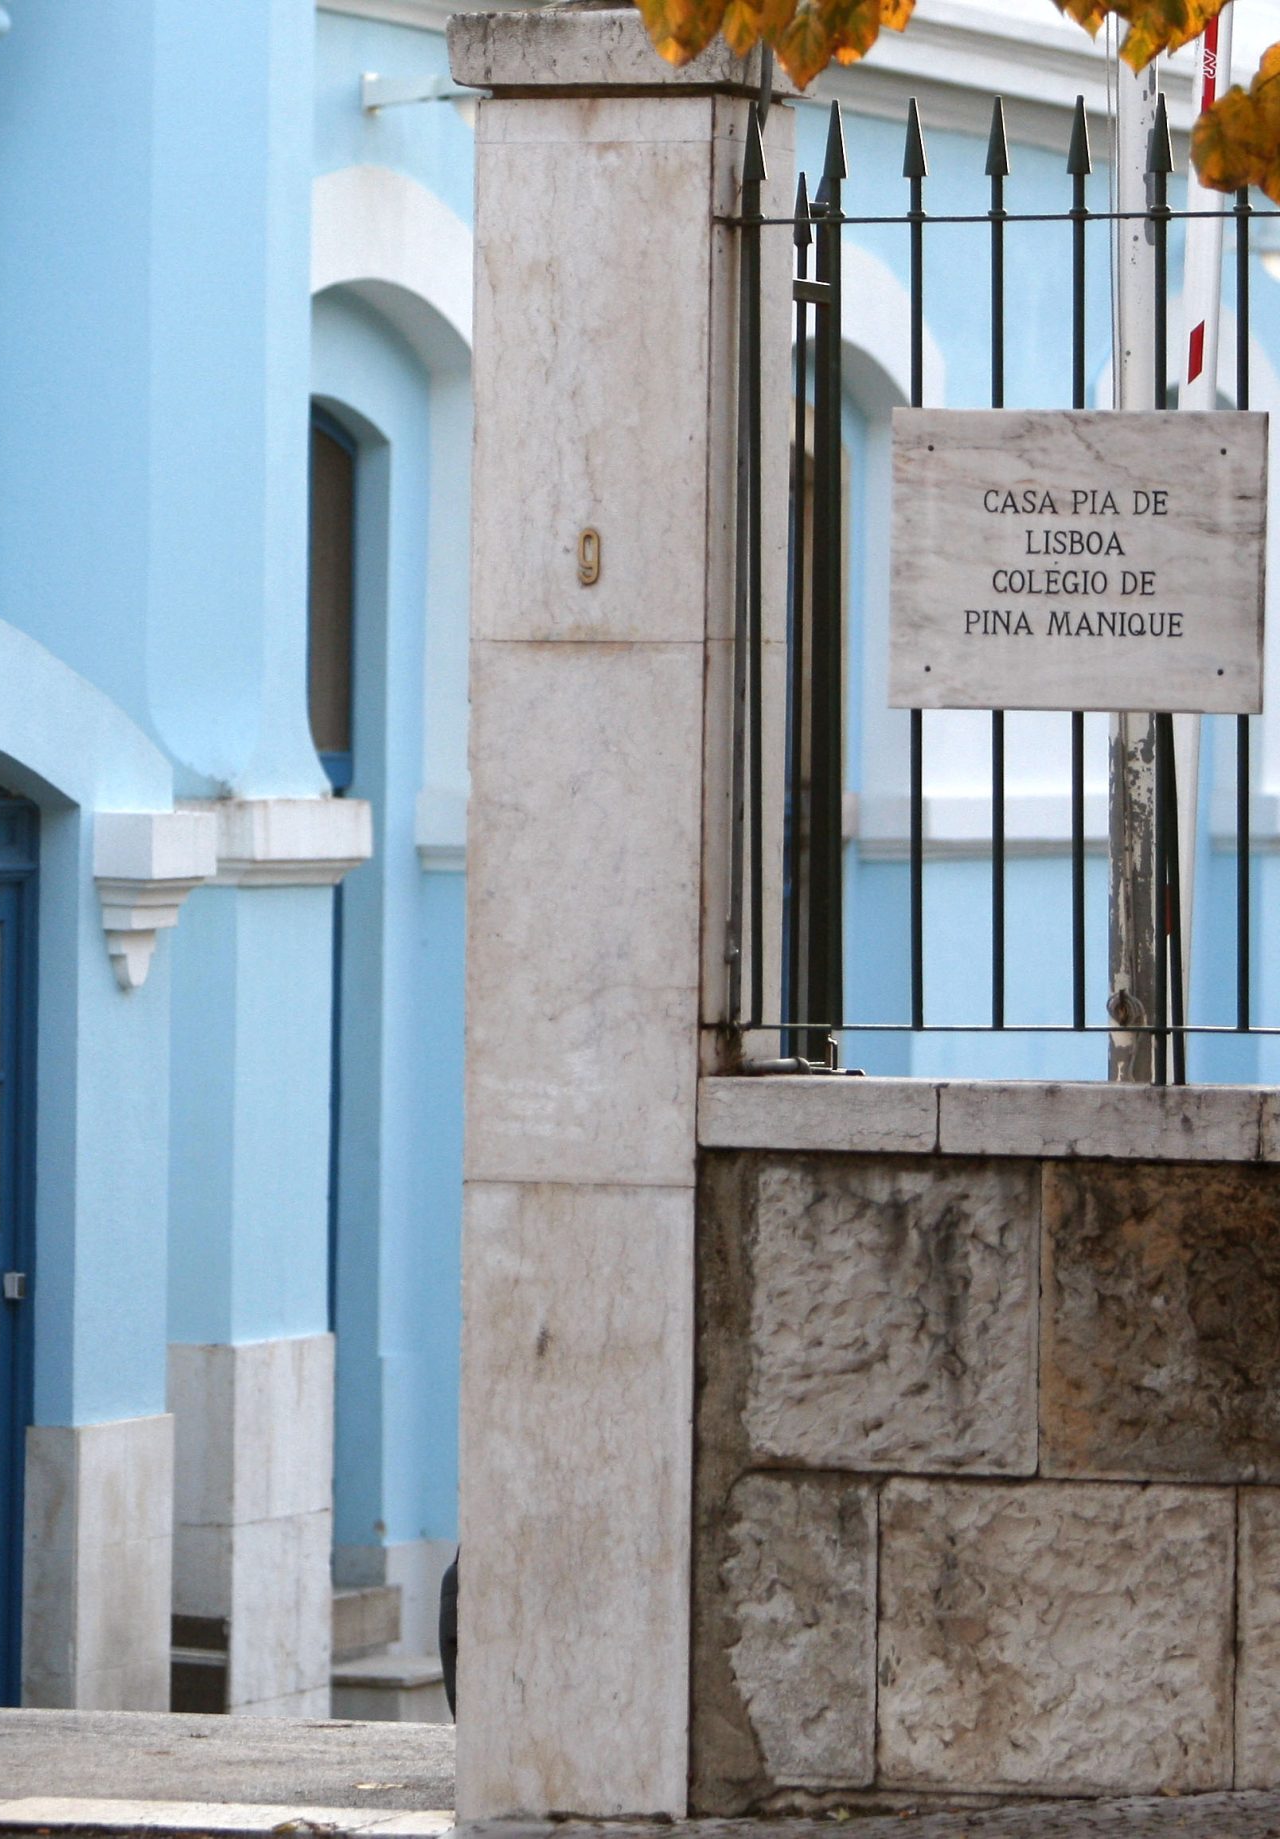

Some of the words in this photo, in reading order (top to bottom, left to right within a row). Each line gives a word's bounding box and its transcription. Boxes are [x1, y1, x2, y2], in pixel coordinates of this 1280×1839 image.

[984, 489, 1059, 515] CASA
[1071, 489, 1121, 515] PIA
[1132, 490, 1169, 516] DE
[1025, 529, 1126, 556] LISBOA
[577, 527, 600, 587] 9
[1120, 570, 1157, 597] DE
[964, 610, 1034, 636] PINA
[1046, 611, 1185, 638] MANIQUE
